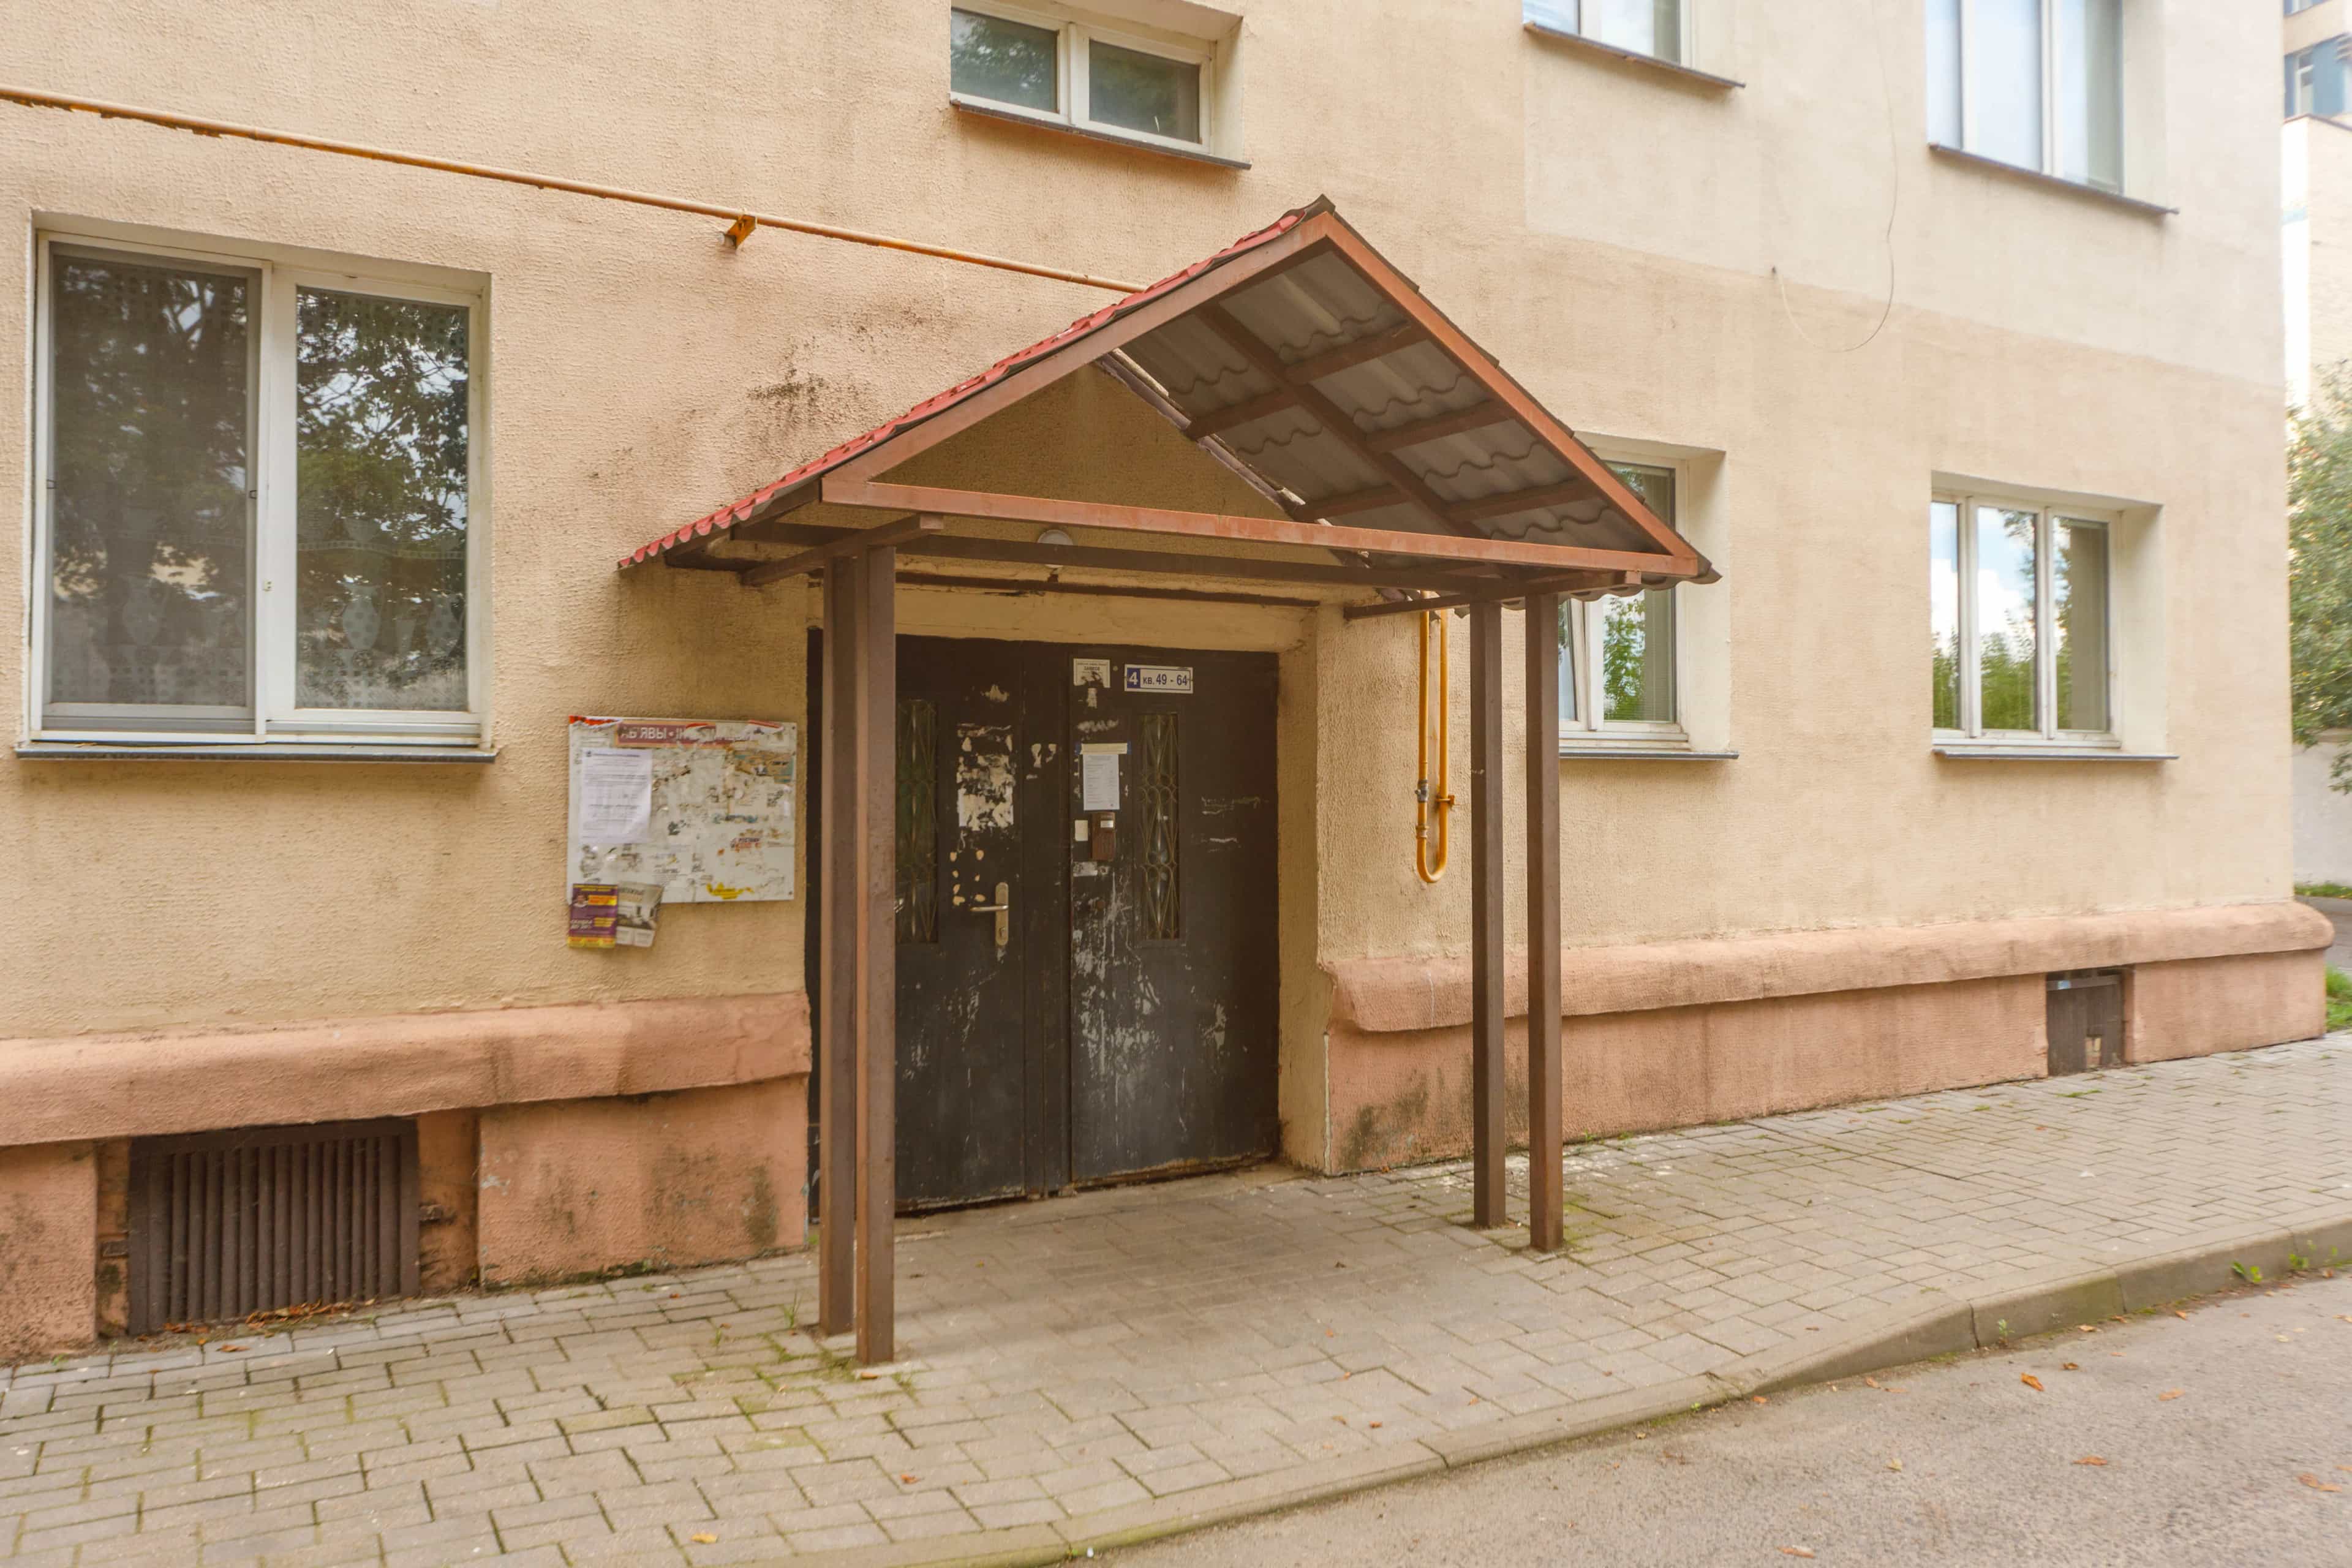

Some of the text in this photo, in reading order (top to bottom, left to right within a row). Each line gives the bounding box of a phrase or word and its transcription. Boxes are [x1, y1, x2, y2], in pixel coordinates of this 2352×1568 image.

[1129, 671, 1138, 685] 4
[1156, 674, 1167, 685] 49
[1177, 674, 1188, 686] 64
